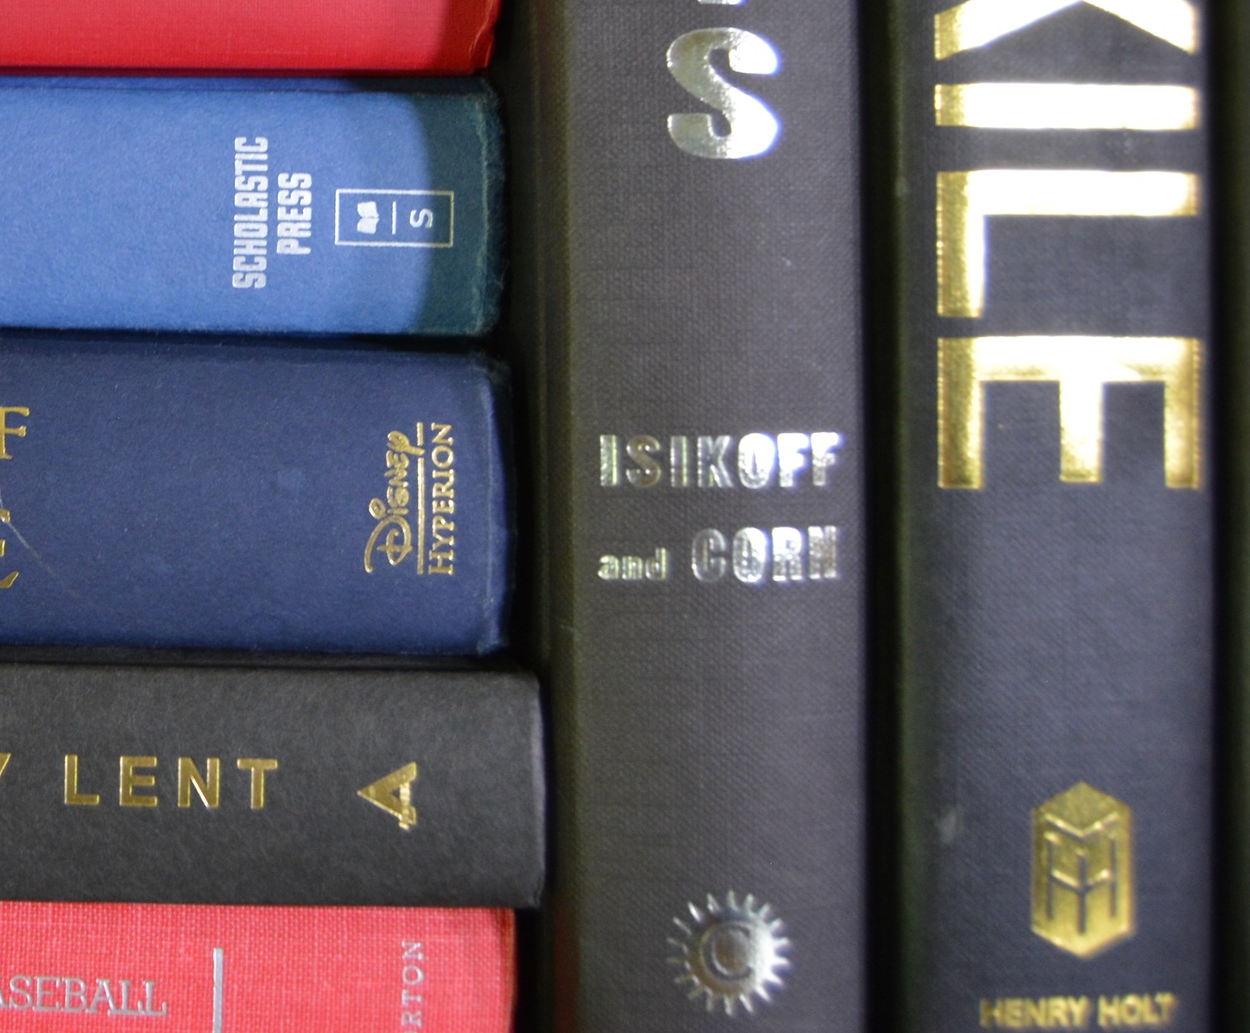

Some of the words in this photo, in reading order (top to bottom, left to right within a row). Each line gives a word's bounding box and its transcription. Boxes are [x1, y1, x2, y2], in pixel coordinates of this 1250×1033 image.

[232, 136, 269, 289] SCHOLASTIC
[276, 172, 313, 256] PRESS
[363, 429, 426, 574] Disney
[428, 421, 456, 576] HYPERION
[599, 432, 842, 489] ISIKOFF
[597, 547, 668, 581] and
[690, 525, 839, 584] CORN
[62, 753, 280, 809] LENT
[400, 939, 424, 1033] RTON
[979, 995, 1090, 1030] HENRY
[1097, 990, 1180, 1029] HOLT
